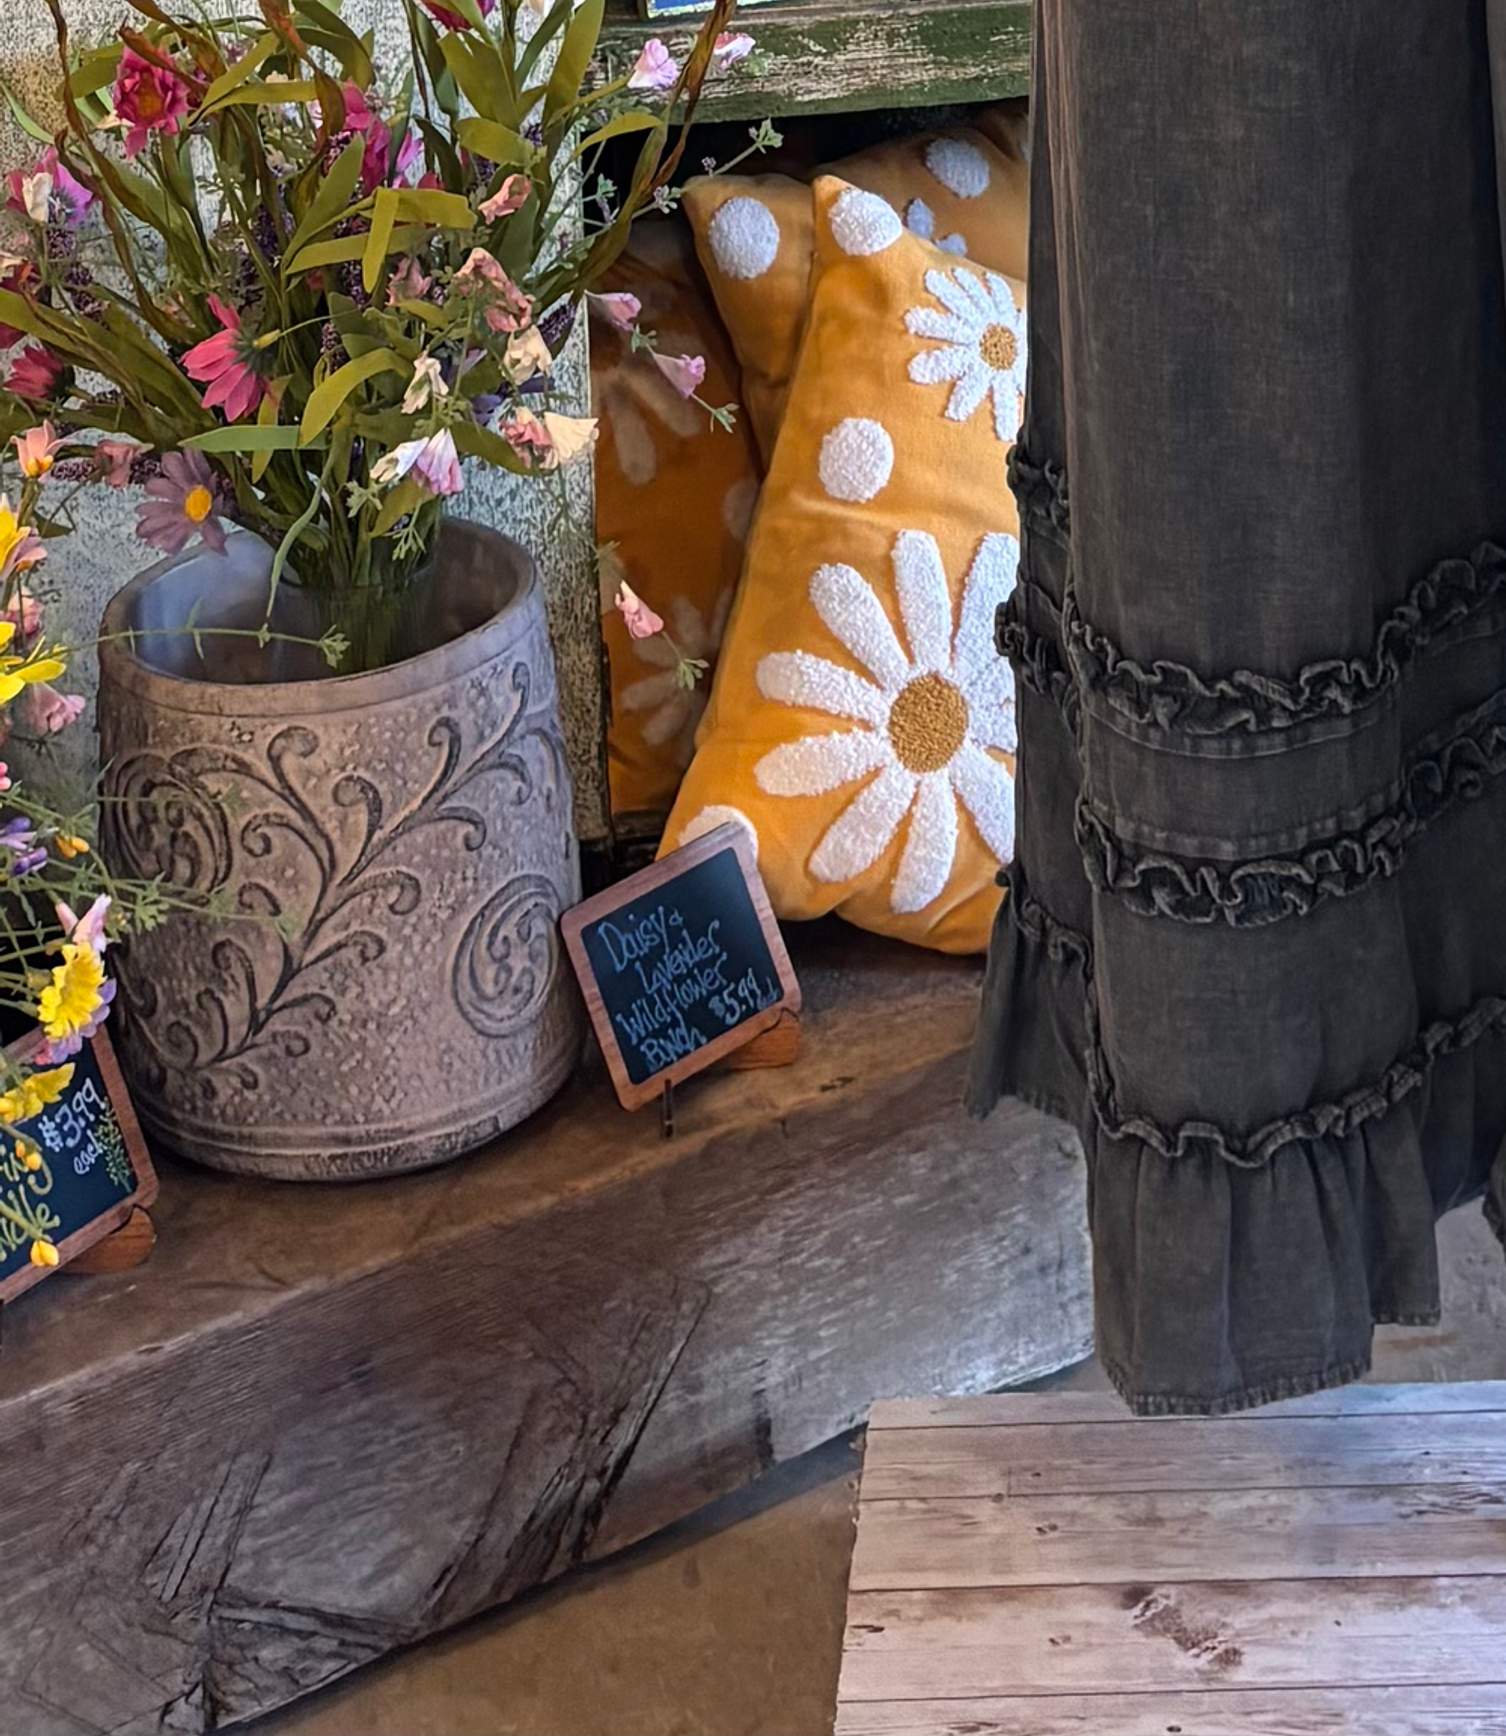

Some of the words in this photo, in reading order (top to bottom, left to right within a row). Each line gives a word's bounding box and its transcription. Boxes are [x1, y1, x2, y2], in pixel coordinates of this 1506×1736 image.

[598, 905, 670, 973] Daisy
[708, 967, 762, 1026] $5.99
[37, 1077, 106, 1153] $3.99
